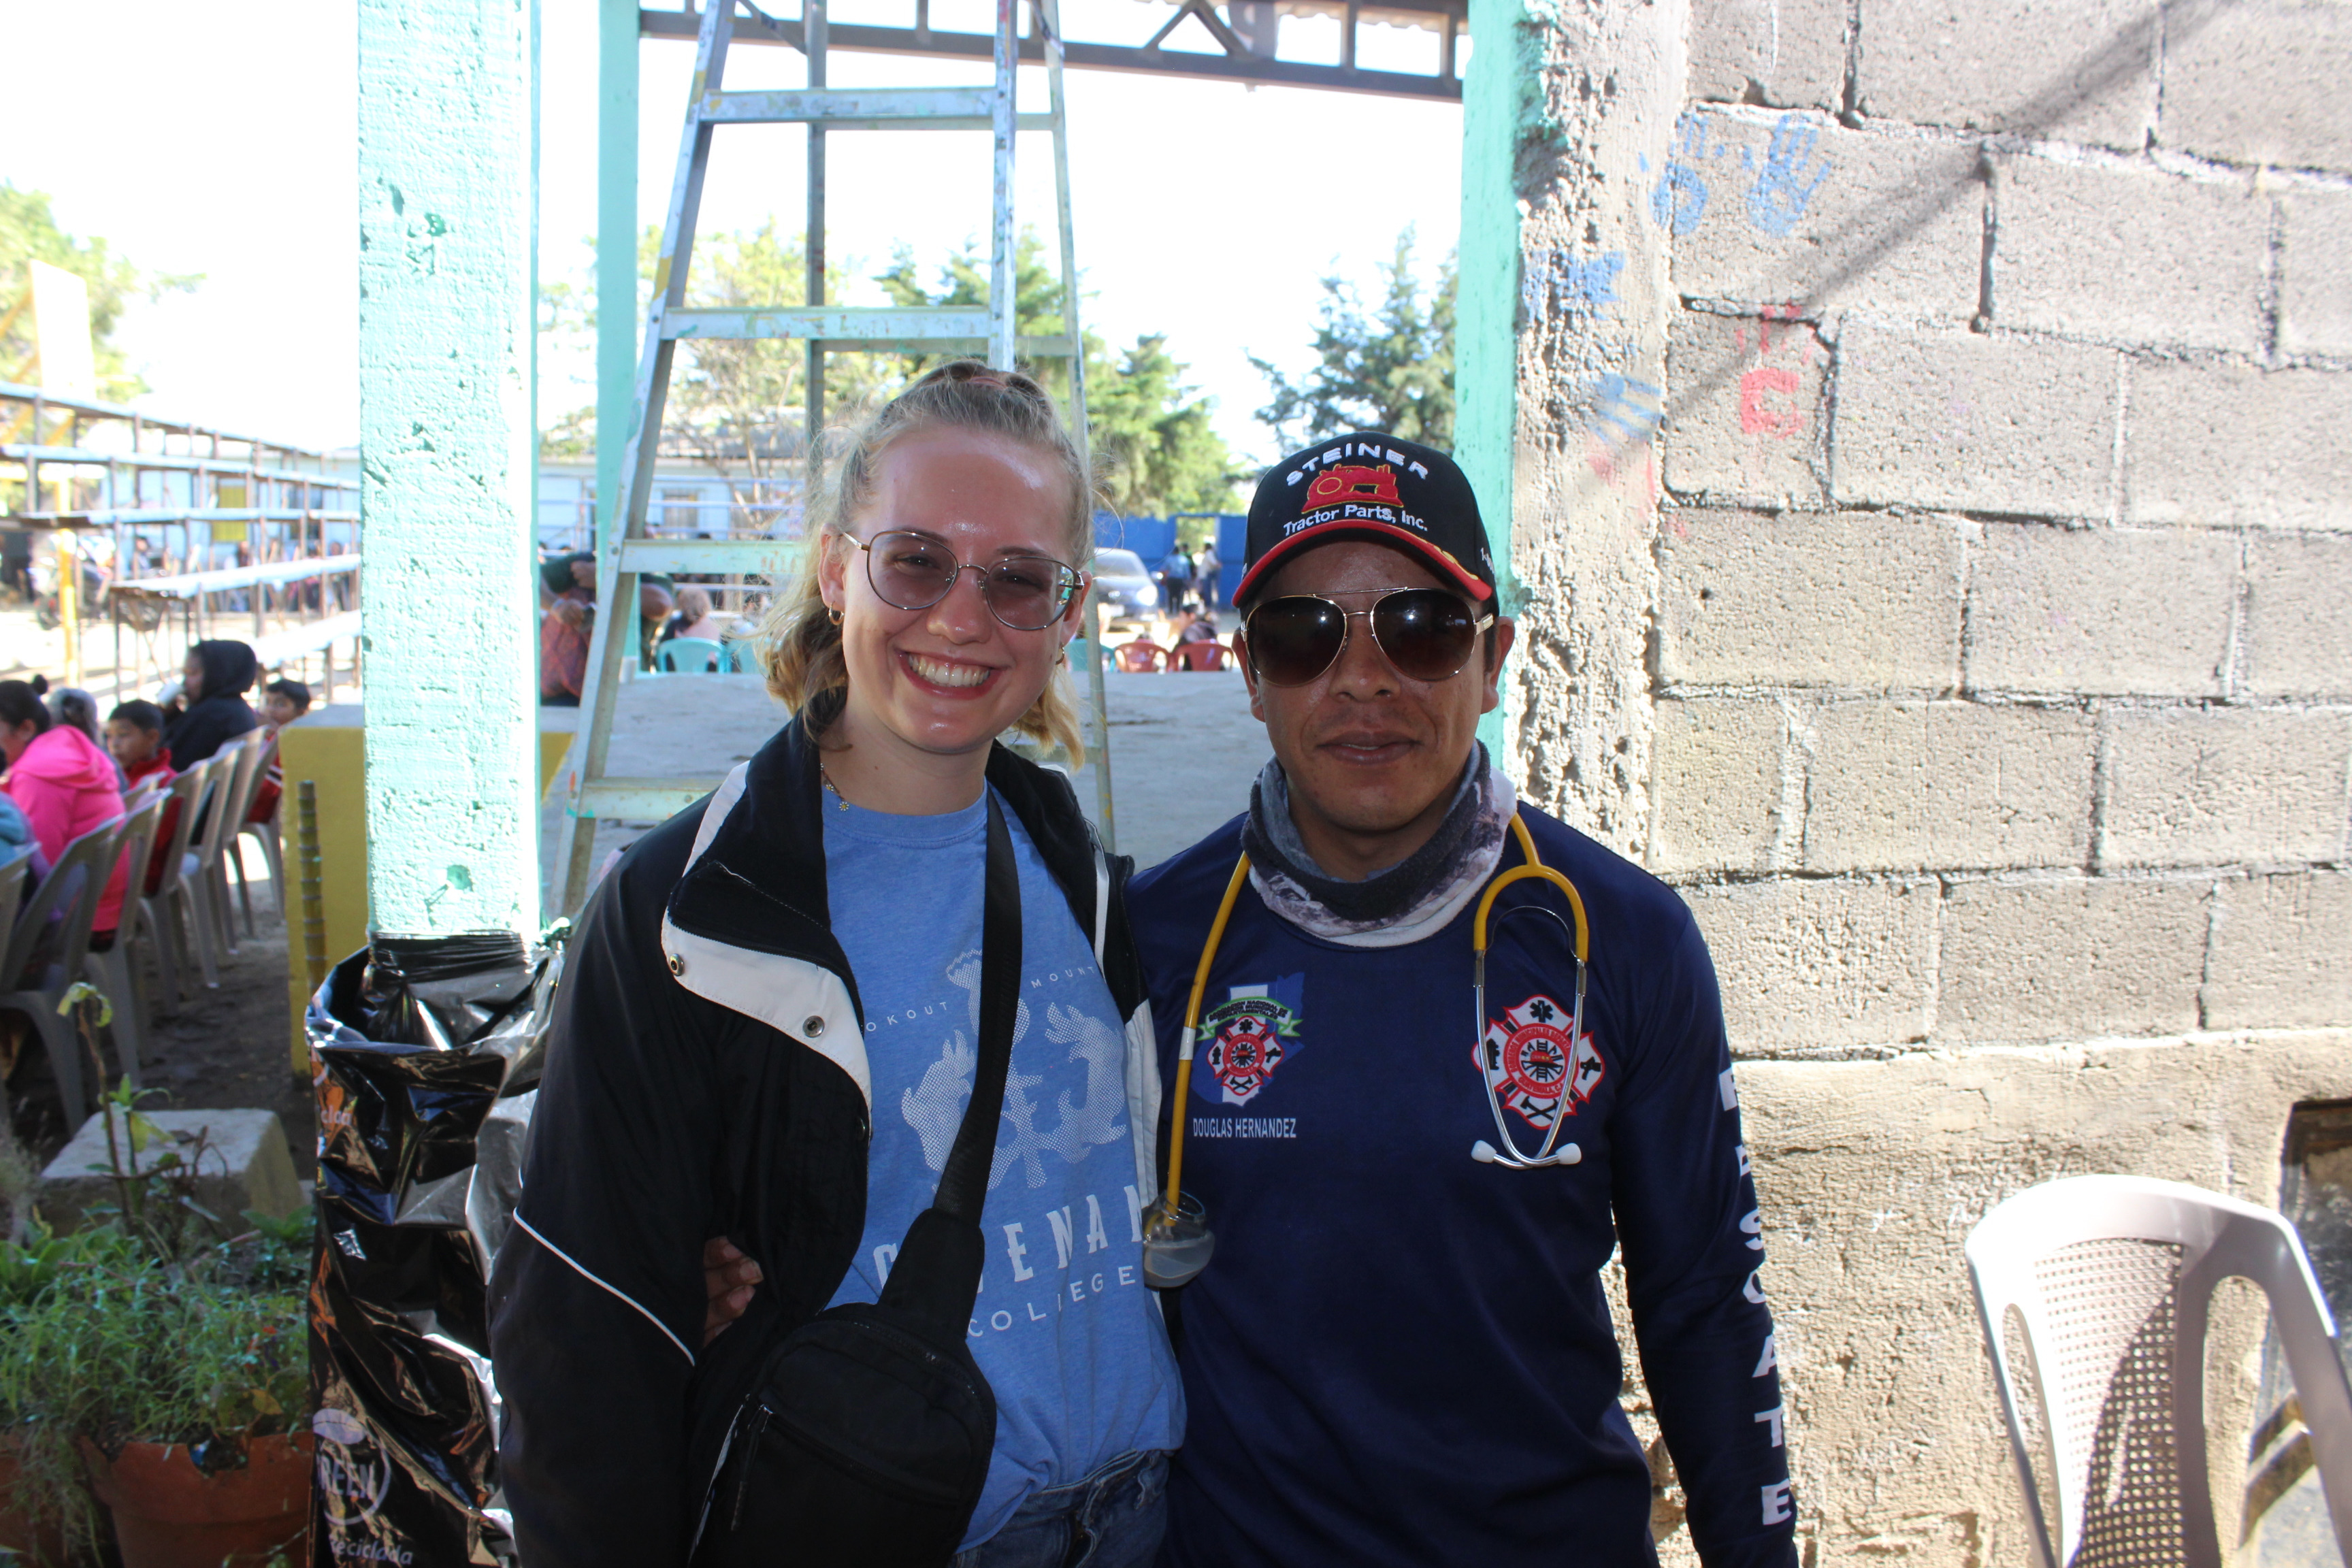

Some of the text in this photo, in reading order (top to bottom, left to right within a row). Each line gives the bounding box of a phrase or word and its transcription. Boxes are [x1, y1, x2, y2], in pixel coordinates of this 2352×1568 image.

[1287, 443, 1428, 487] STEINER
[1284, 504, 1428, 536] Tractor Parts, Inc.
[866, 966, 1094, 1032] OKOUT MOUNT
[1193, 1118, 1296, 1138] DOUGLAS HERNANDEZ
[873, 1185, 1143, 1294] CENA
